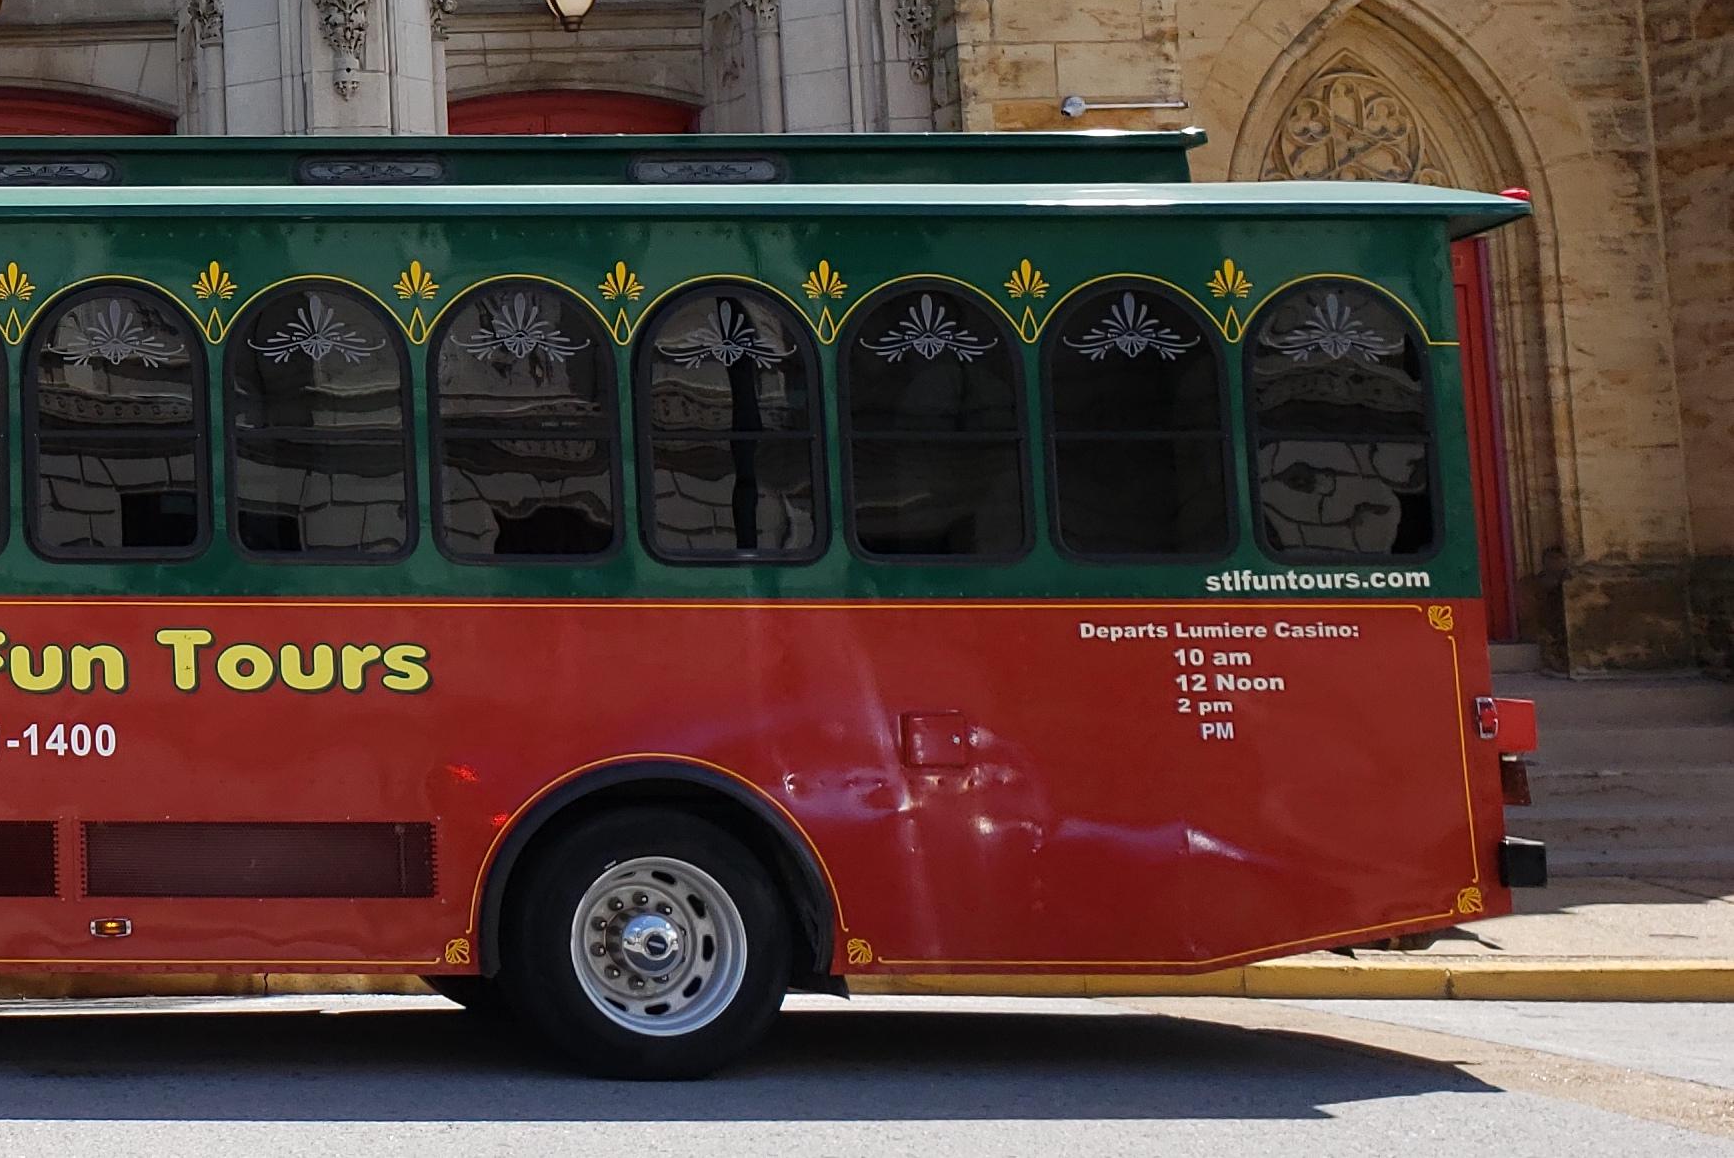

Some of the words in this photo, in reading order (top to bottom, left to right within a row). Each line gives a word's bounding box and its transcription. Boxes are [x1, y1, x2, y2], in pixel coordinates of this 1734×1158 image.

[1205, 569, 1431, 593] stlfuntours.com
[1079, 622, 1169, 642] Departs
[1174, 621, 1268, 639] Lumiere
[1274, 620, 1360, 639] Casino:
[155, 628, 434, 694] Tours
[1174, 648, 1205, 667] 10
[1212, 651, 1252, 667] am
[1175, 673, 1208, 692] 12
[1216, 673, 1286, 692] Noon
[1177, 697, 1192, 714] 2
[1198, 700, 1234, 716] pm
[1201, 721, 1235, 741] PM
